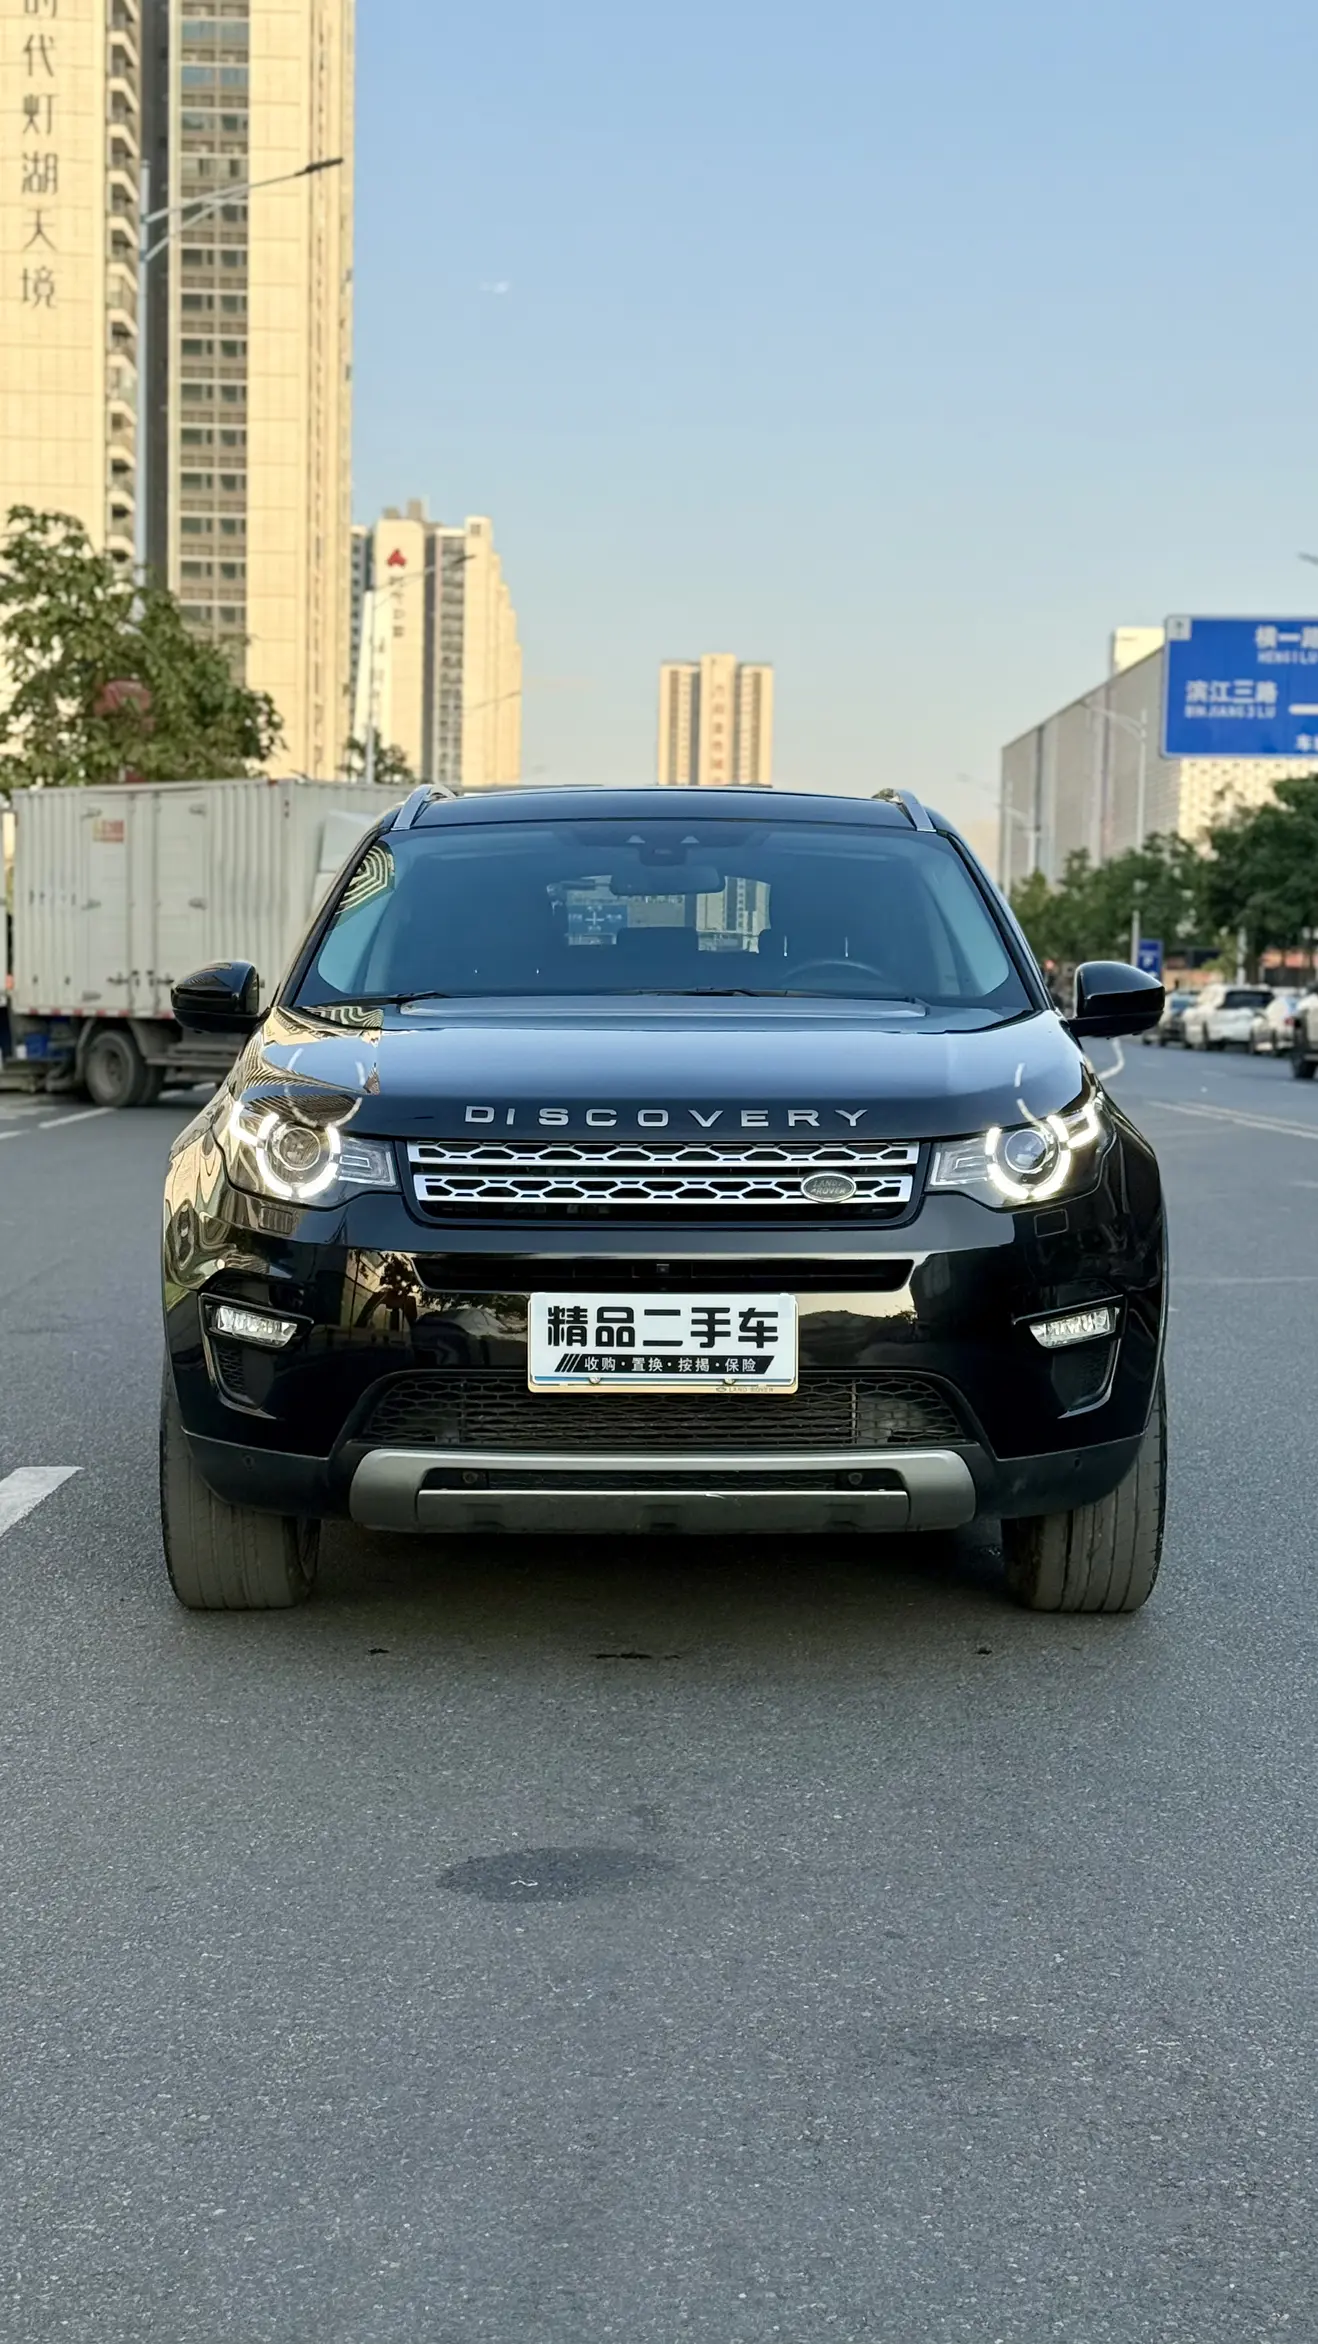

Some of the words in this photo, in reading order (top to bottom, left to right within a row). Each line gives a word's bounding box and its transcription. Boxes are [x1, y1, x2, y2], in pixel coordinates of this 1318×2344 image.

[464, 1105, 868, 1128] DISCOVERY
[547, 1305, 779, 1349] 精品二手车
